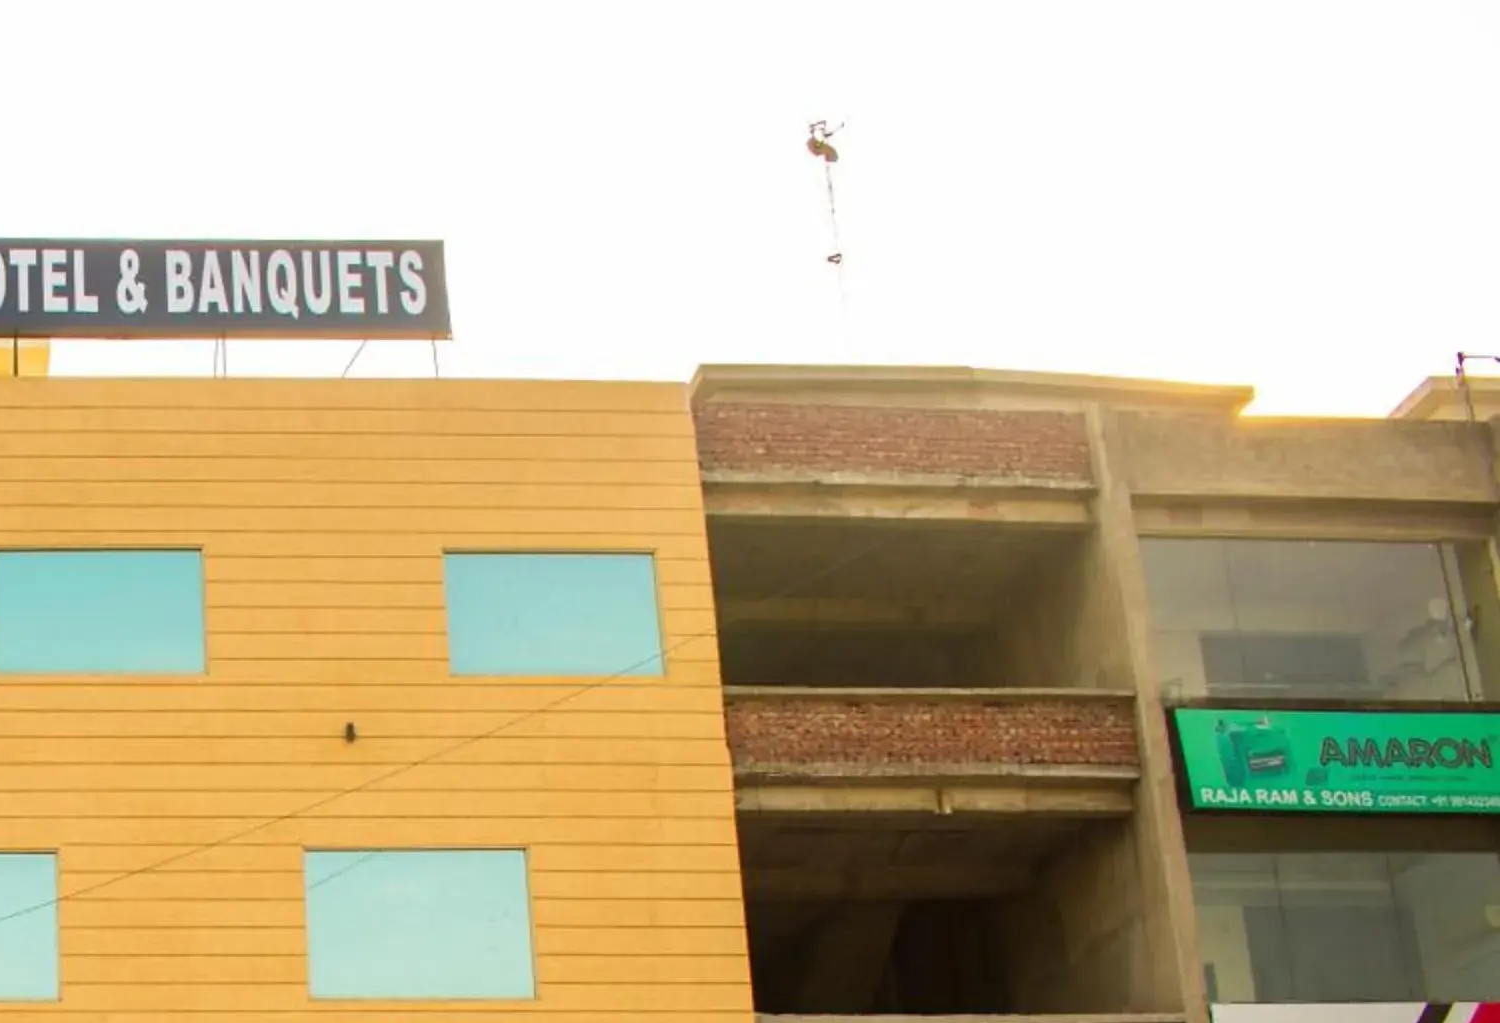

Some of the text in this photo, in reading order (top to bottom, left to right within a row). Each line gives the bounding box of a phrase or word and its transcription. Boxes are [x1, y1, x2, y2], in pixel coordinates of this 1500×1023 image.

[115, 249, 148, 314] &
[165, 250, 428, 320] BANQUETS
[1319, 736, 1493, 768] AMARON
[1200, 787, 1252, 804] RAJA
[1255, 788, 1299, 805] RAM
[1303, 790, 1317, 806] &
[1321, 789, 1373, 807] SONS
